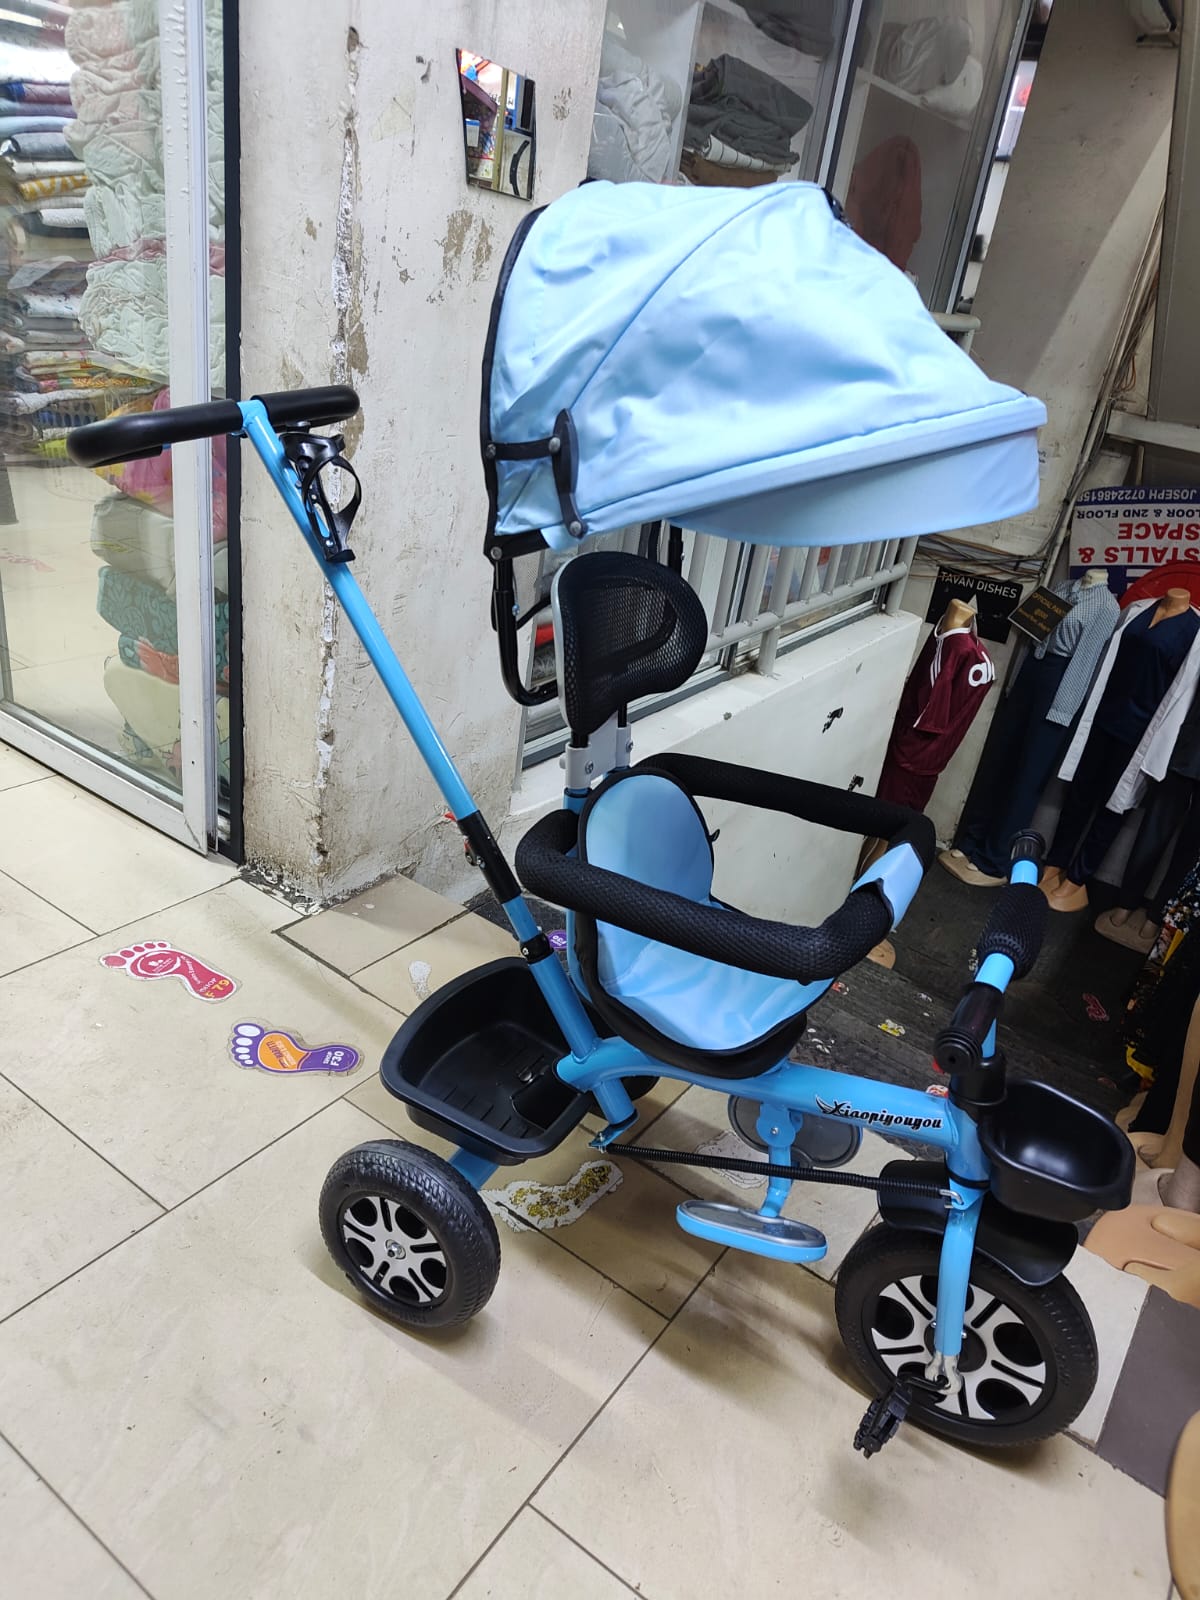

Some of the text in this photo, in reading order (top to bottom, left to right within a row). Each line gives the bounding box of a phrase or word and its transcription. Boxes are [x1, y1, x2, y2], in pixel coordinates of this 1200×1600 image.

[1149, 489, 1197, 500] JOSEPH
[1077, 510, 1119, 519] FLOOR
[1123, 509, 1149, 518] 2ND
[1153, 509, 1162, 518] &
[1118, 523, 1200, 540] SPACE
[1078, 546, 1200, 564] STALLS &
[941, 571, 1018, 599] TAVAN DISHES
[330, 1050, 345, 1066] F30
